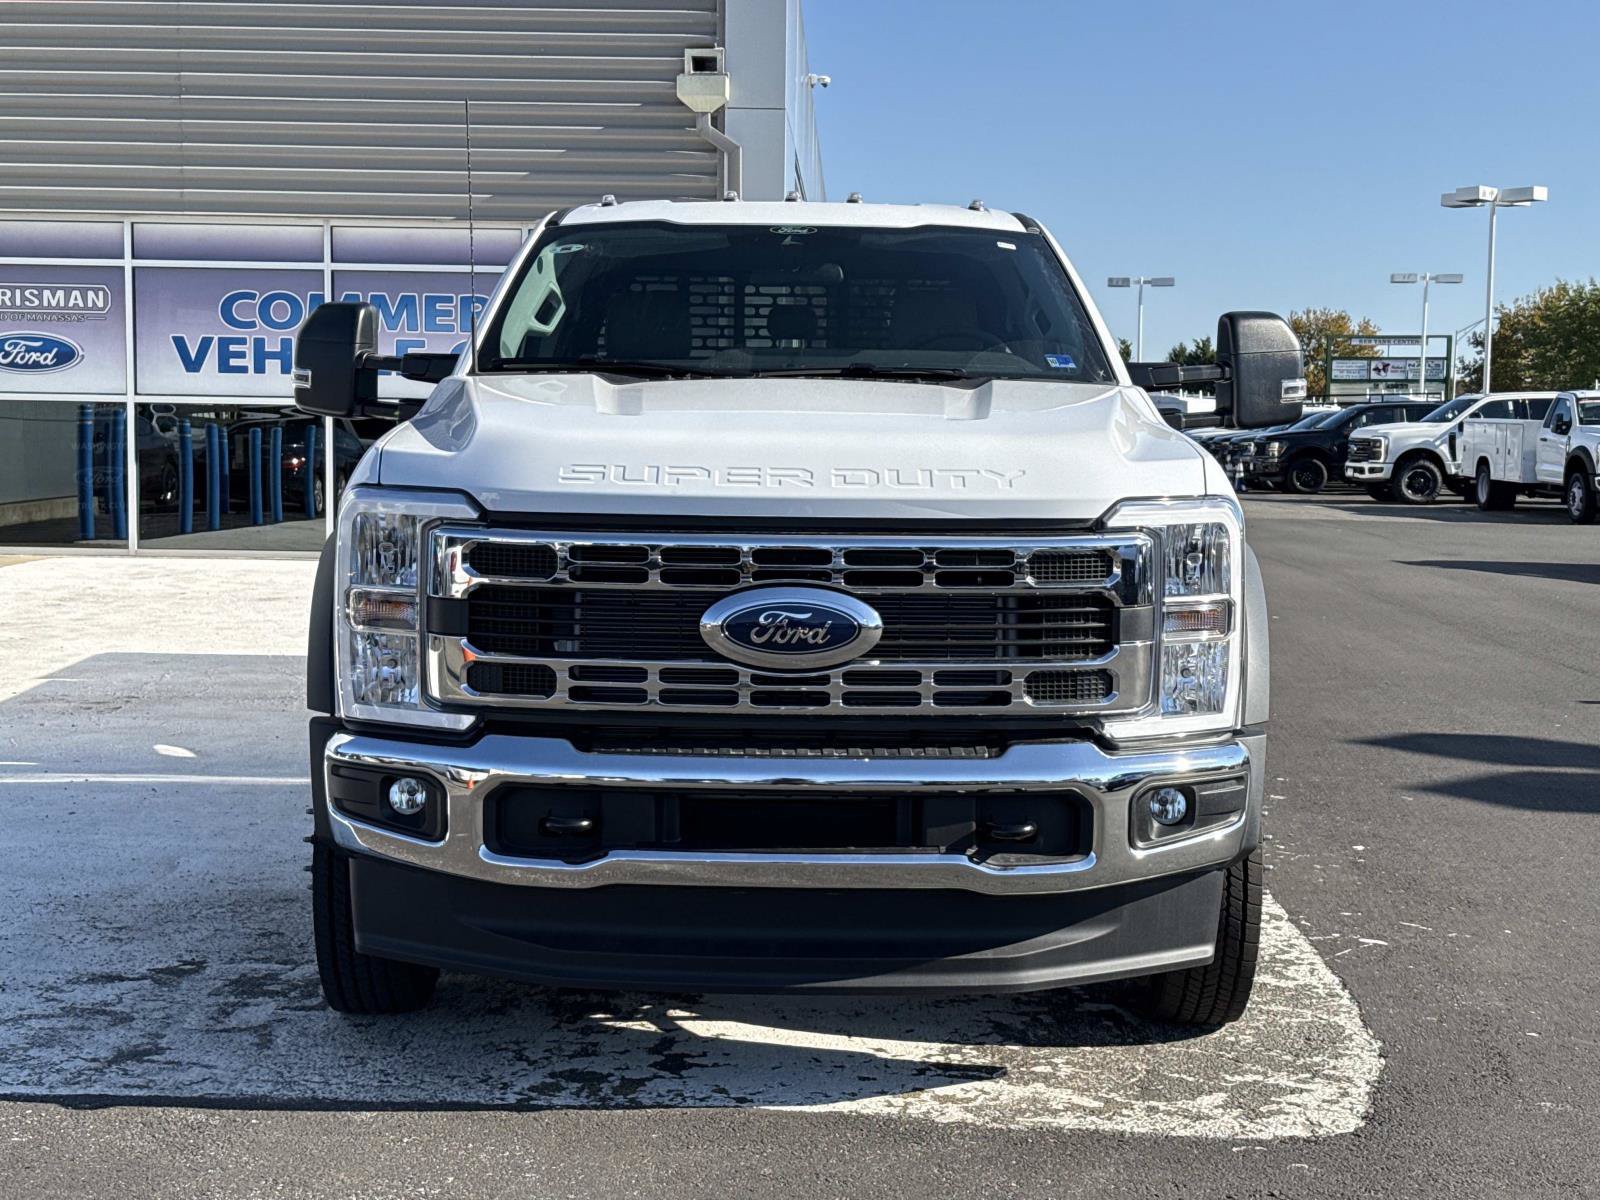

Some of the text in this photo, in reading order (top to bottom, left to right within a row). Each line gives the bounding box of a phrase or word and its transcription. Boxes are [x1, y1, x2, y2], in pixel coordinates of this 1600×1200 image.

[10, 313, 24, 321] OF
[27, 313, 85, 322] MANASSAS
[0, 339, 58, 365] Ford
[558, 463, 1026, 490] SUPER DUTY
[750, 610, 833, 645] Ford
